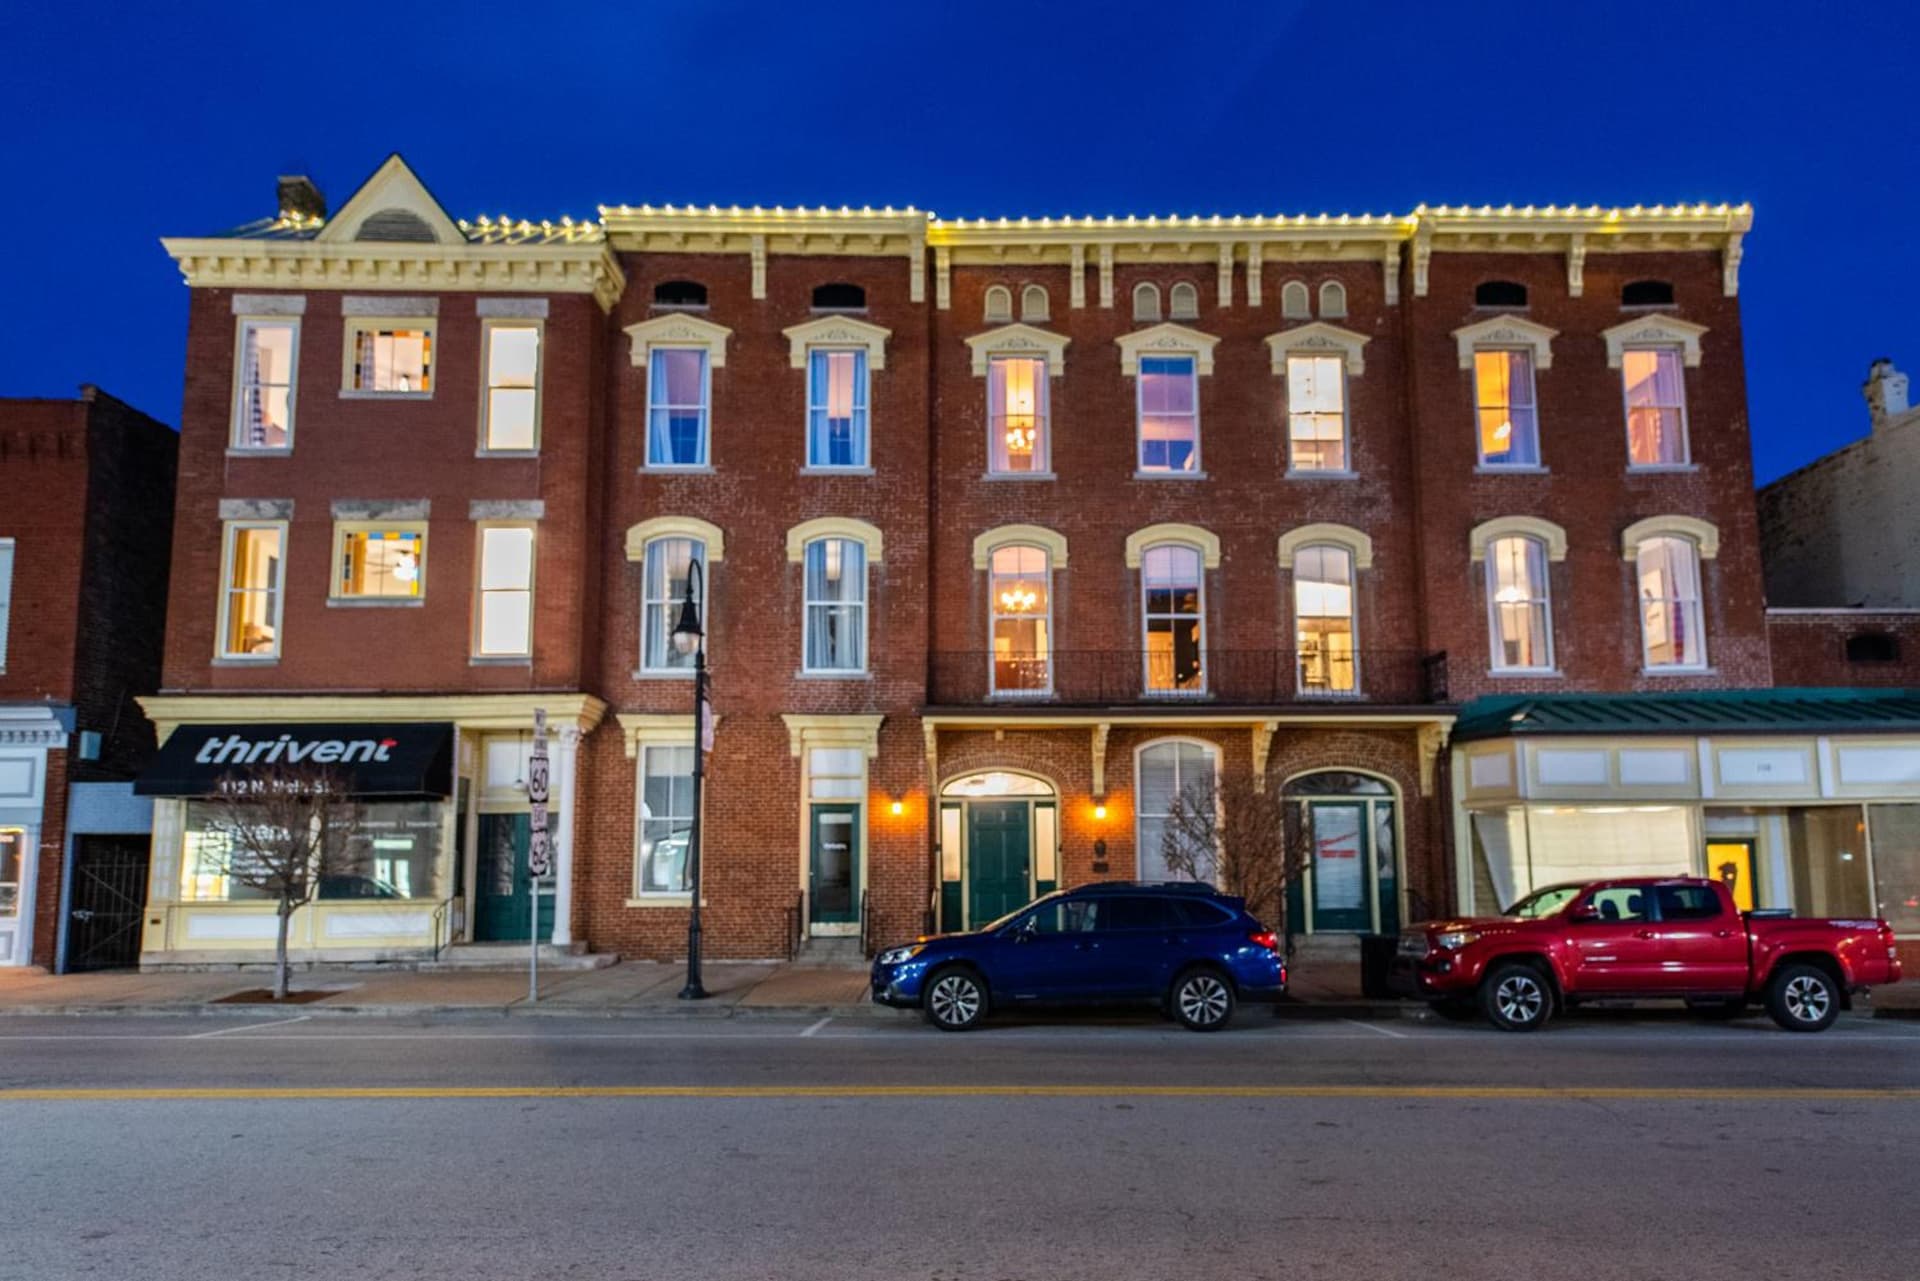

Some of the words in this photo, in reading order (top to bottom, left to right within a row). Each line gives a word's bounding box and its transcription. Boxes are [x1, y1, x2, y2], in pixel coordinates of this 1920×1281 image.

[195, 734, 398, 763] thrivent
[532, 768, 548, 793] 60
[533, 841, 547, 866] 62
